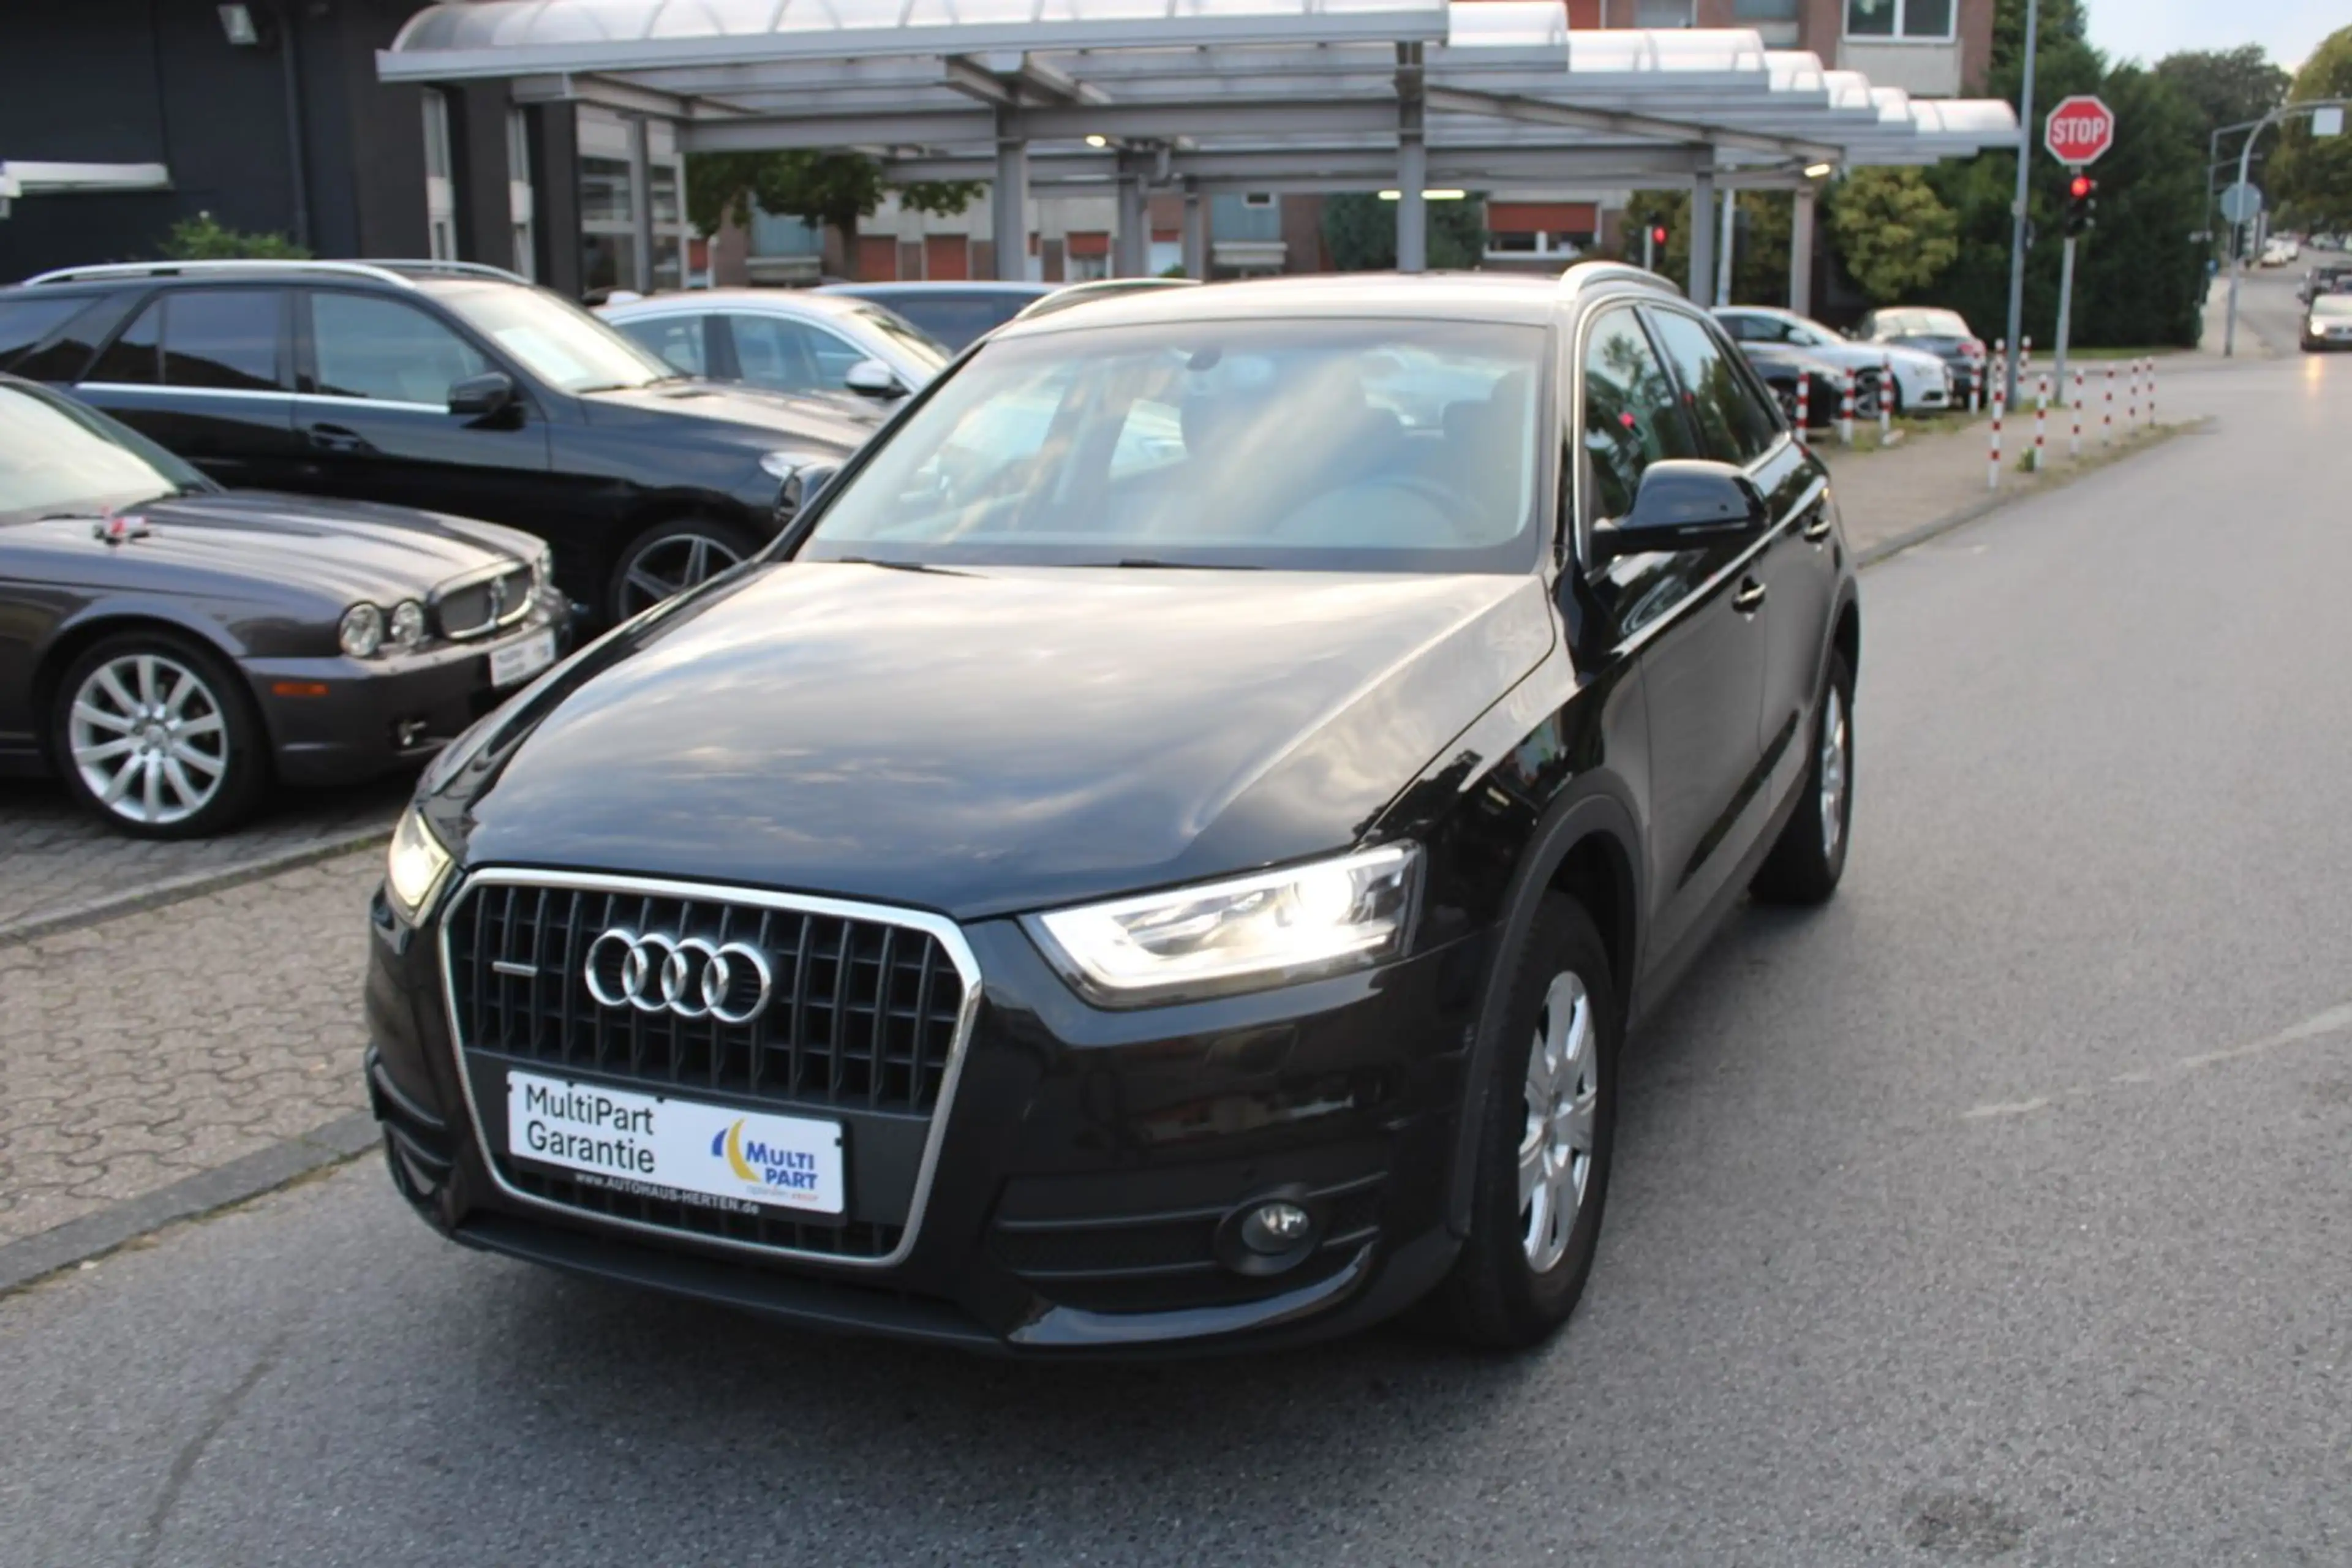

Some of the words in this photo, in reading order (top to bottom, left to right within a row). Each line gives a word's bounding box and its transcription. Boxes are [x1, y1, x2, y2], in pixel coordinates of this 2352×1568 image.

[2052, 118, 2105, 145] STOP
[526, 1084, 654, 1135] MultiPart
[527, 1120, 655, 1174] Garantie
[747, 1140, 814, 1170] MULTI
[575, 1172, 760, 1215] www.AUTOHAUS-HERTEN.de
[765, 1167, 818, 1190] PART
